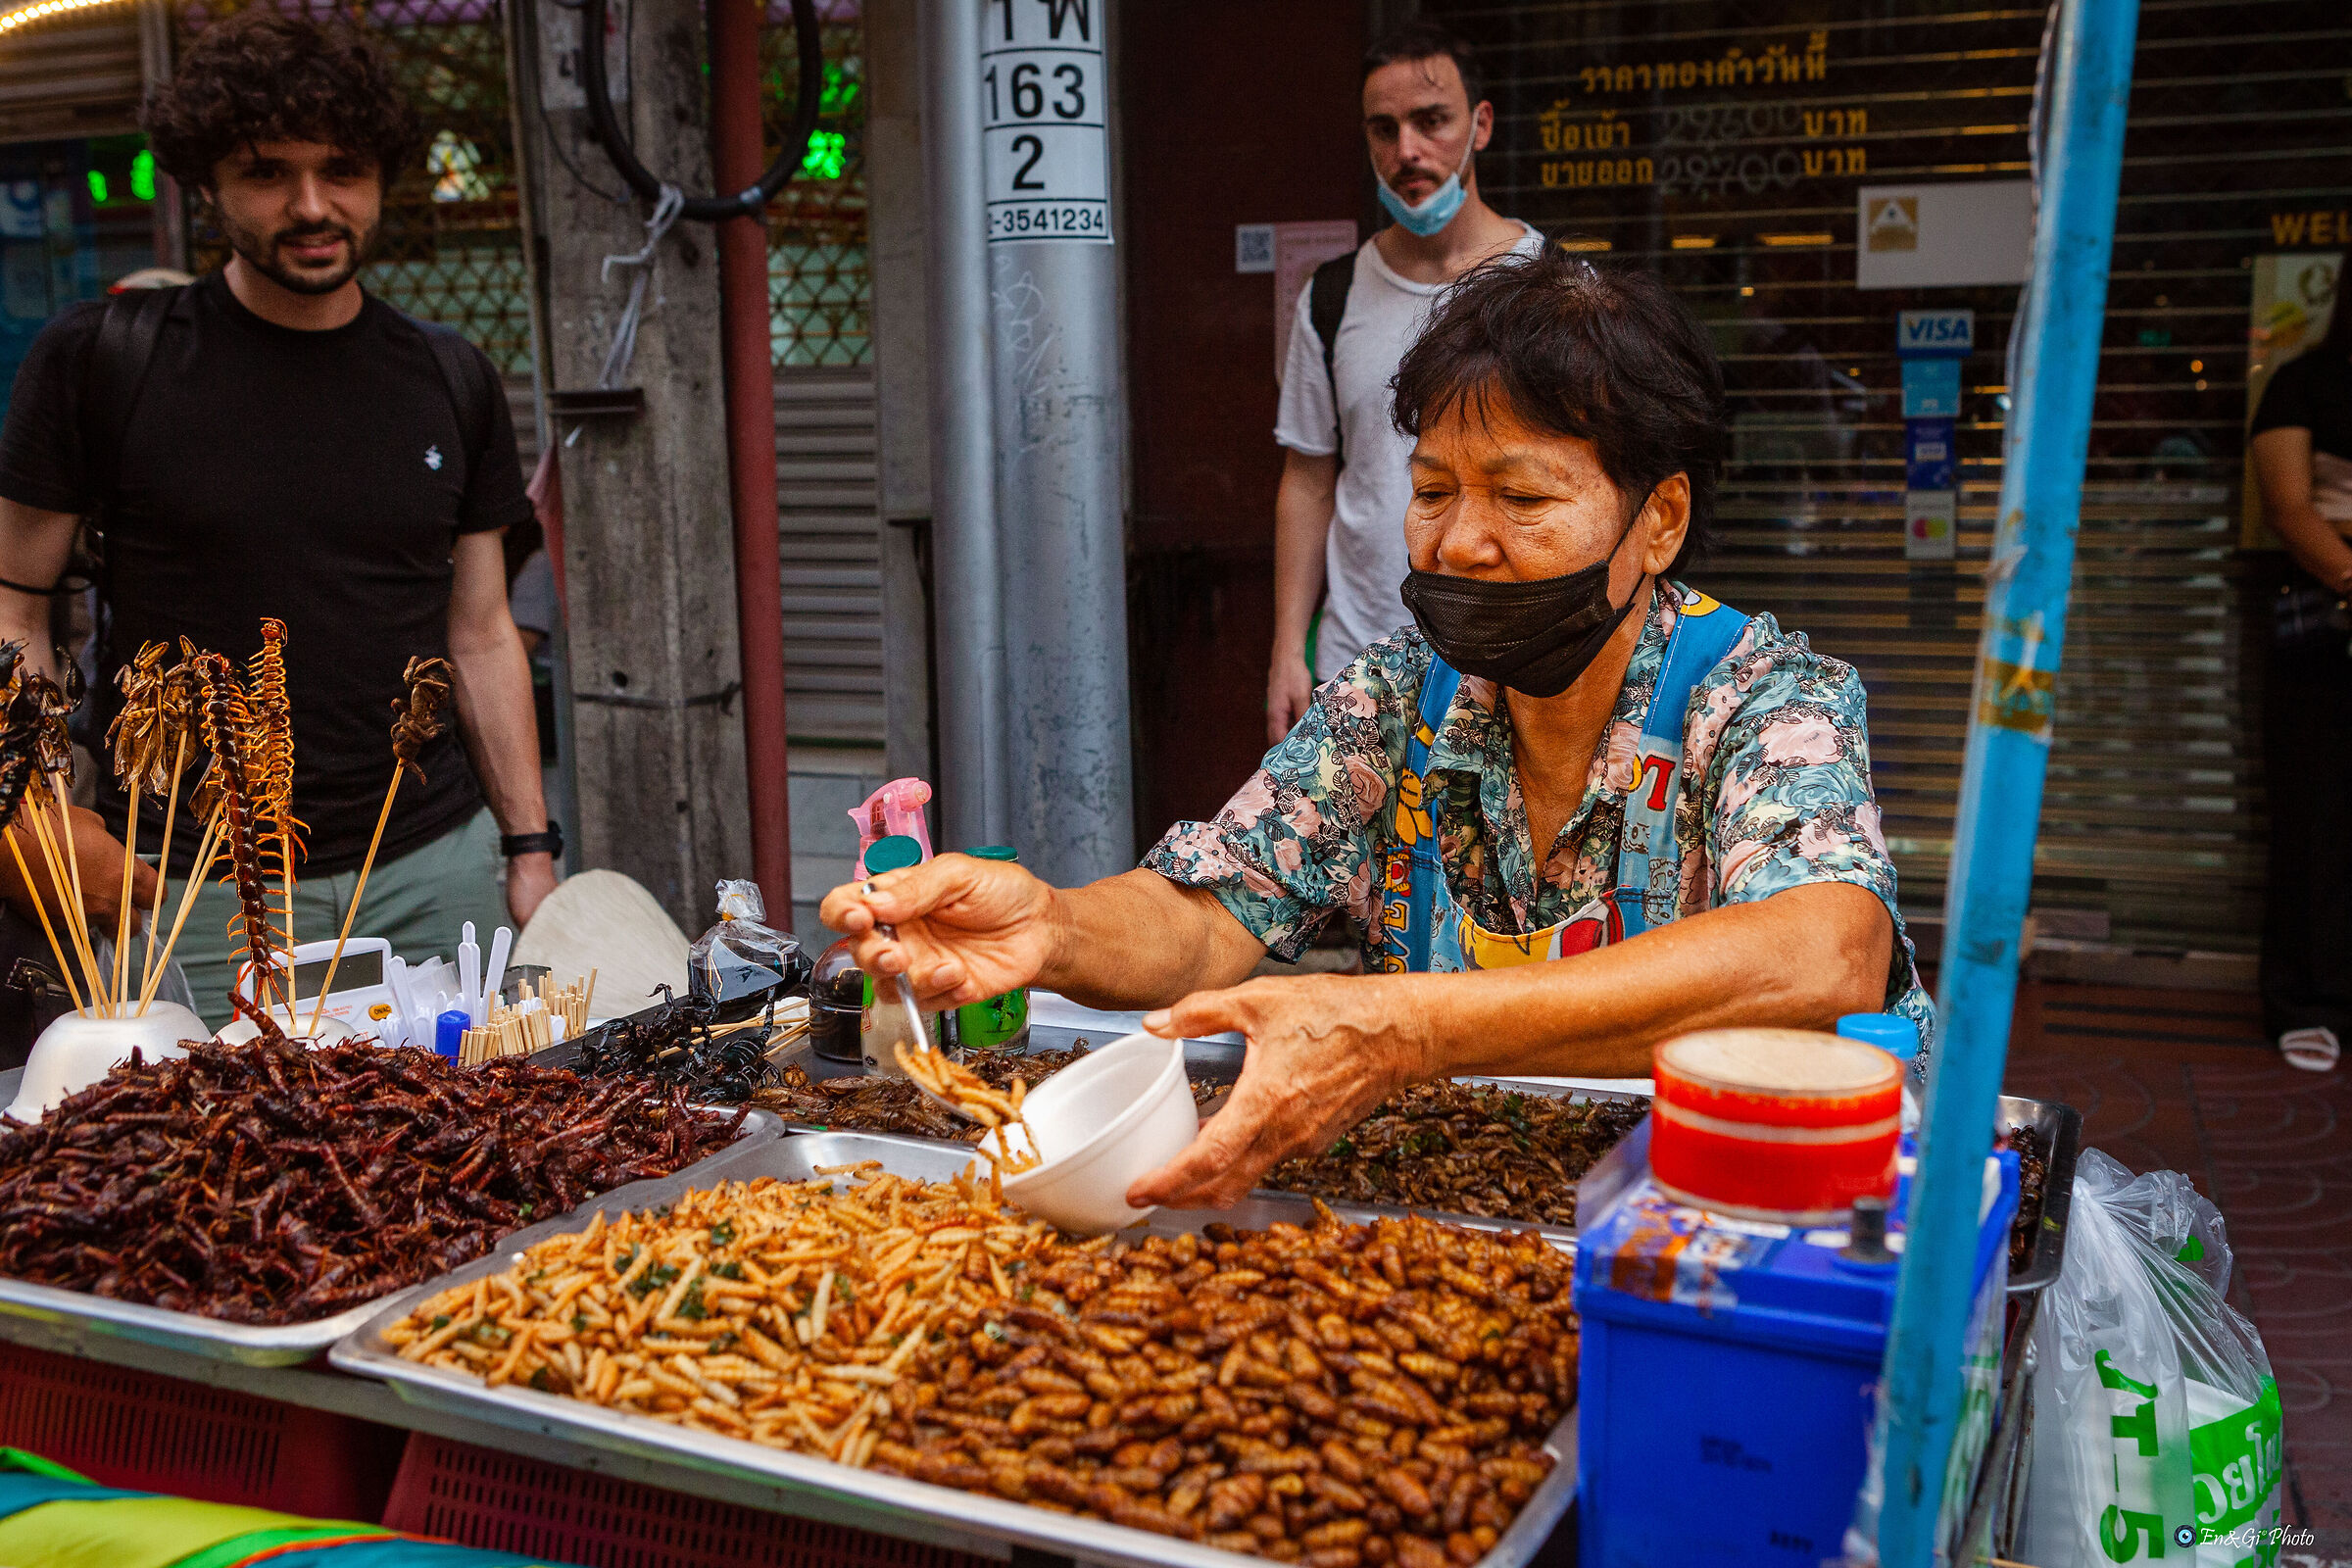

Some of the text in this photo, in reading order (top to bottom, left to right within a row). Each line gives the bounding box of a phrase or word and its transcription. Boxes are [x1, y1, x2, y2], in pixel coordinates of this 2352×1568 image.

[984, 63, 1085, 120] 163
[1802, 109, 1868, 138] บาท
[1011, 134, 1045, 190] 2
[1541, 156, 1654, 188] ขายออก
[1802, 147, 1867, 177] บาท
[1907, 319, 1970, 341] VISA
